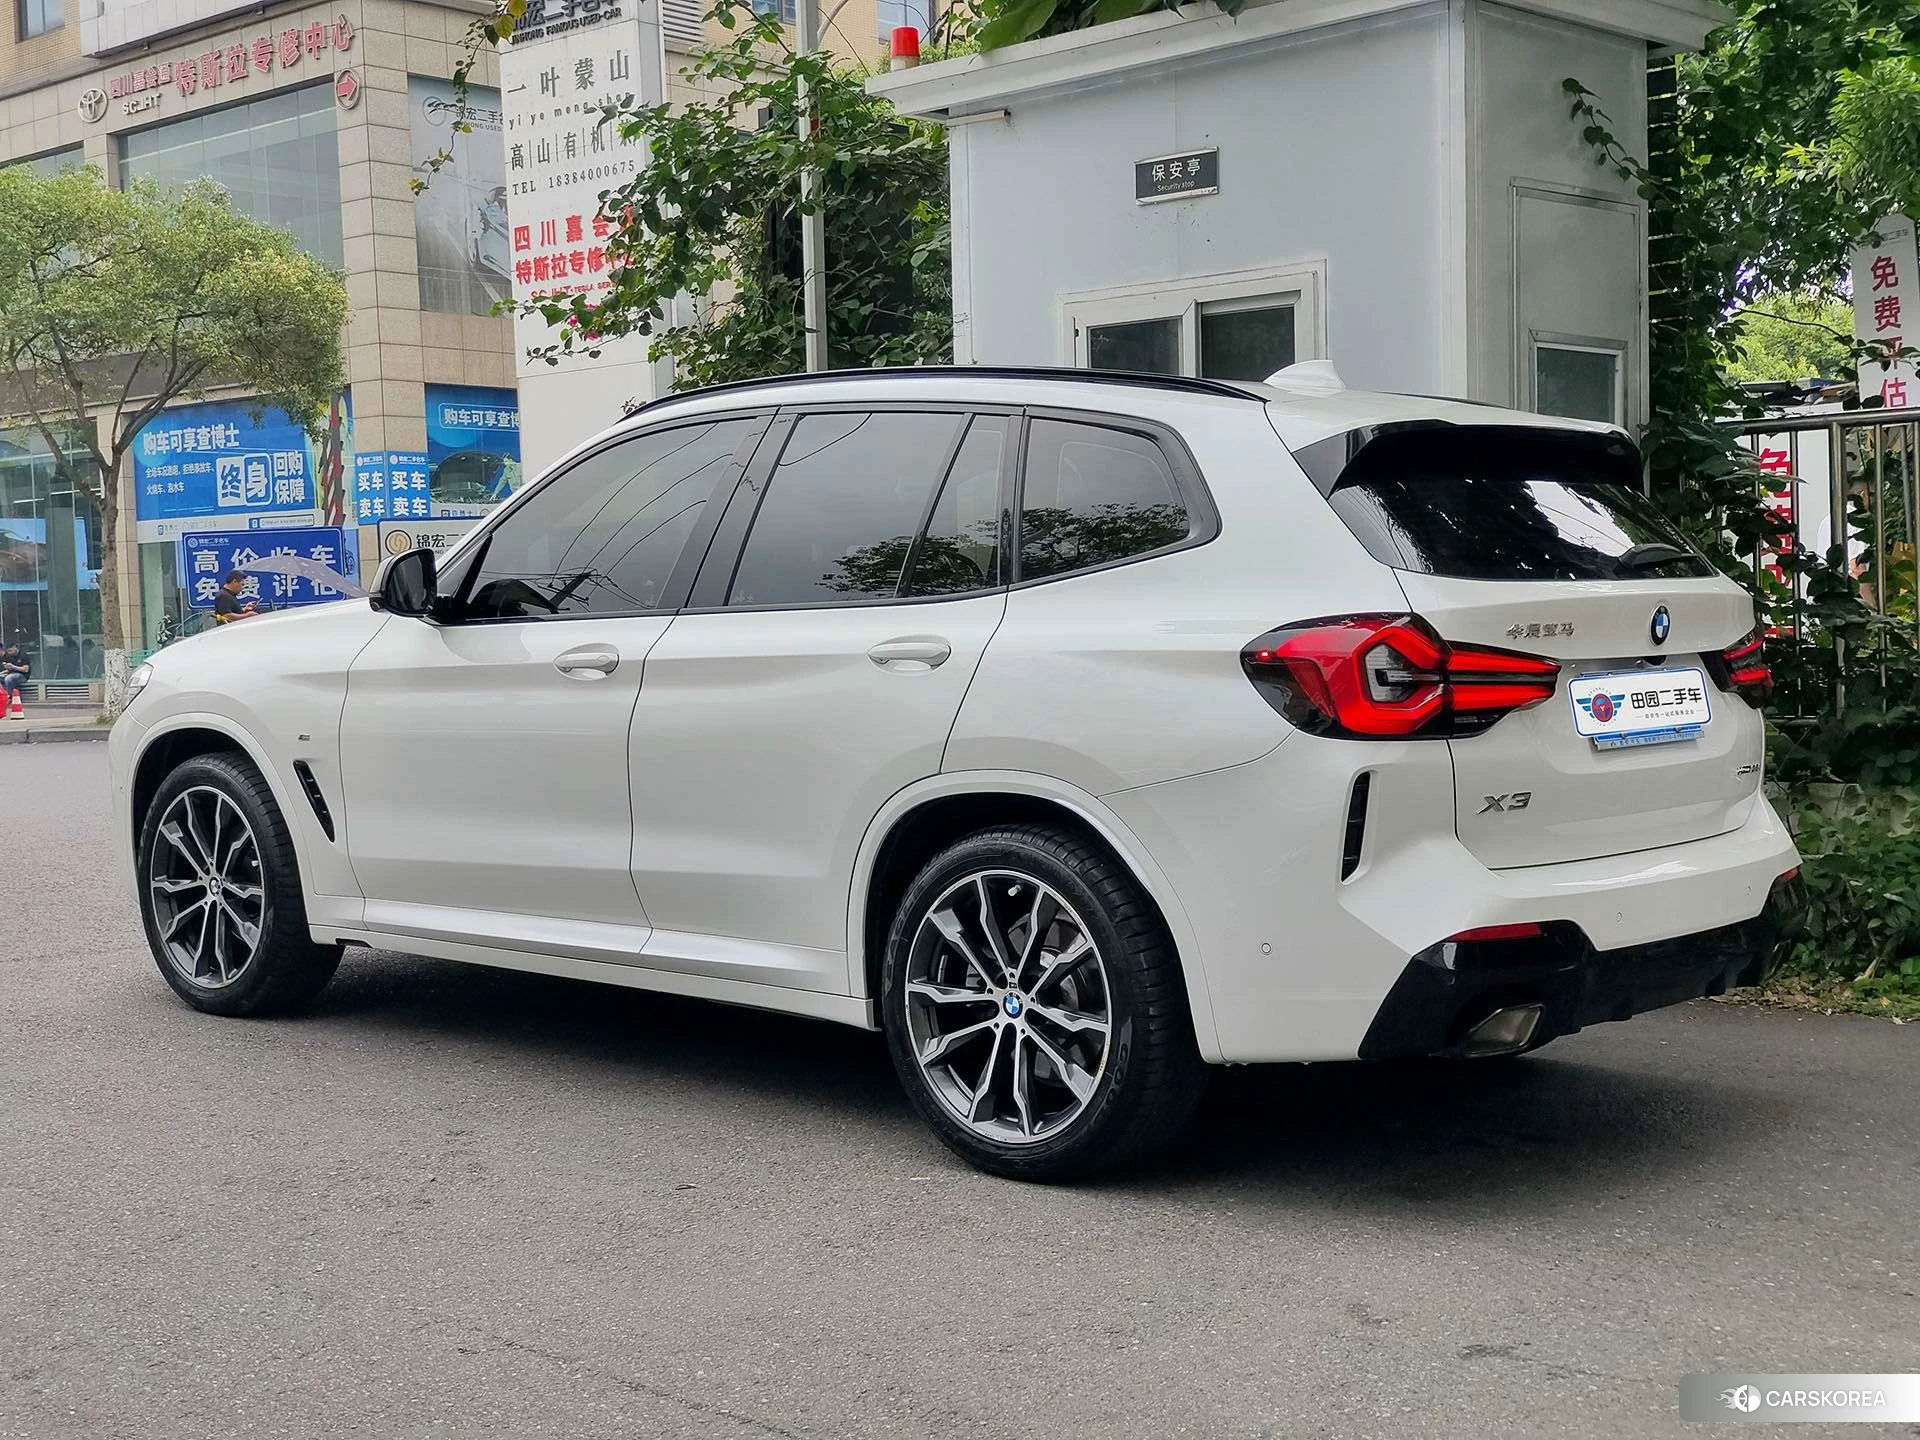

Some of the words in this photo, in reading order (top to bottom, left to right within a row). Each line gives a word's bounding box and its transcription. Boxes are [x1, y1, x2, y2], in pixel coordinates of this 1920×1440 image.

[546, 18, 580, 36] FAMOUS
[580, 7, 623, 27] USED-CAR
[175, 13, 354, 98] 特斯拉专修中心
[507, 50, 630, 98] 一叶蒙山
[509, 114, 522, 131] yi
[530, 111, 545, 126] ye
[512, 180, 537, 195] TEL
[548, 159, 635, 189] 18384000675
[1151, 158, 1201, 182] 保安亭
[143, 422, 240, 456] 购车可享查博士
[273, 451, 304, 478] 回购
[220, 461, 269, 499] 终身
[274, 478, 305, 505] 保障
[358, 471, 384, 492] 买车
[391, 471, 427, 491] 买车
[359, 497, 386, 517] 卖车
[393, 496, 428, 516] 卖车
[1630, 687, 1702, 709] 田园二手车
[1477, 791, 1532, 815] X3
